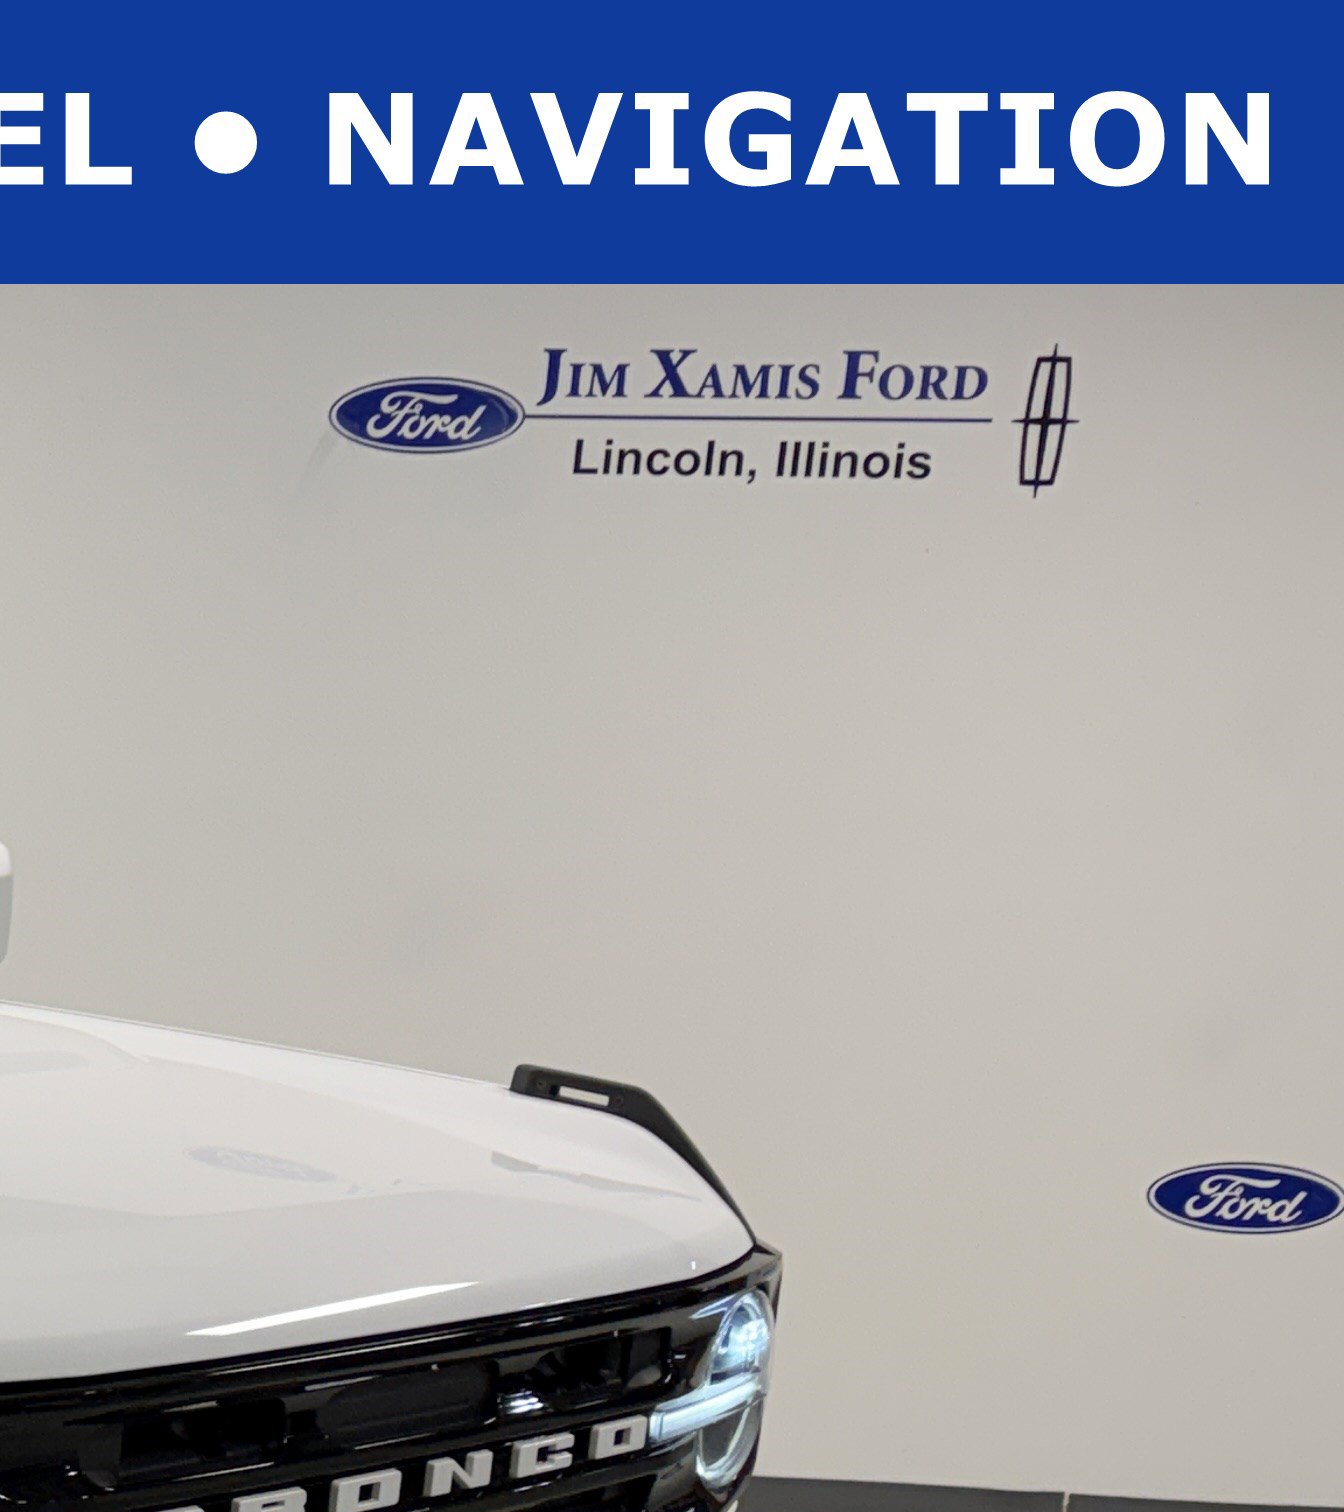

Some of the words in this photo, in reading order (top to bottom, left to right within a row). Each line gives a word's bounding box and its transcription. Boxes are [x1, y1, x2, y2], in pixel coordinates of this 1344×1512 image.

[536, 347, 631, 407] JIM
[642, 349, 821, 400] XAMIS
[836, 350, 989, 401] FORD
[364, 390, 485, 443] Ford
[572, 438, 757, 484] Lincoln,
[775, 440, 932, 480] Illinois
[1183, 1173, 1309, 1224] Ford
